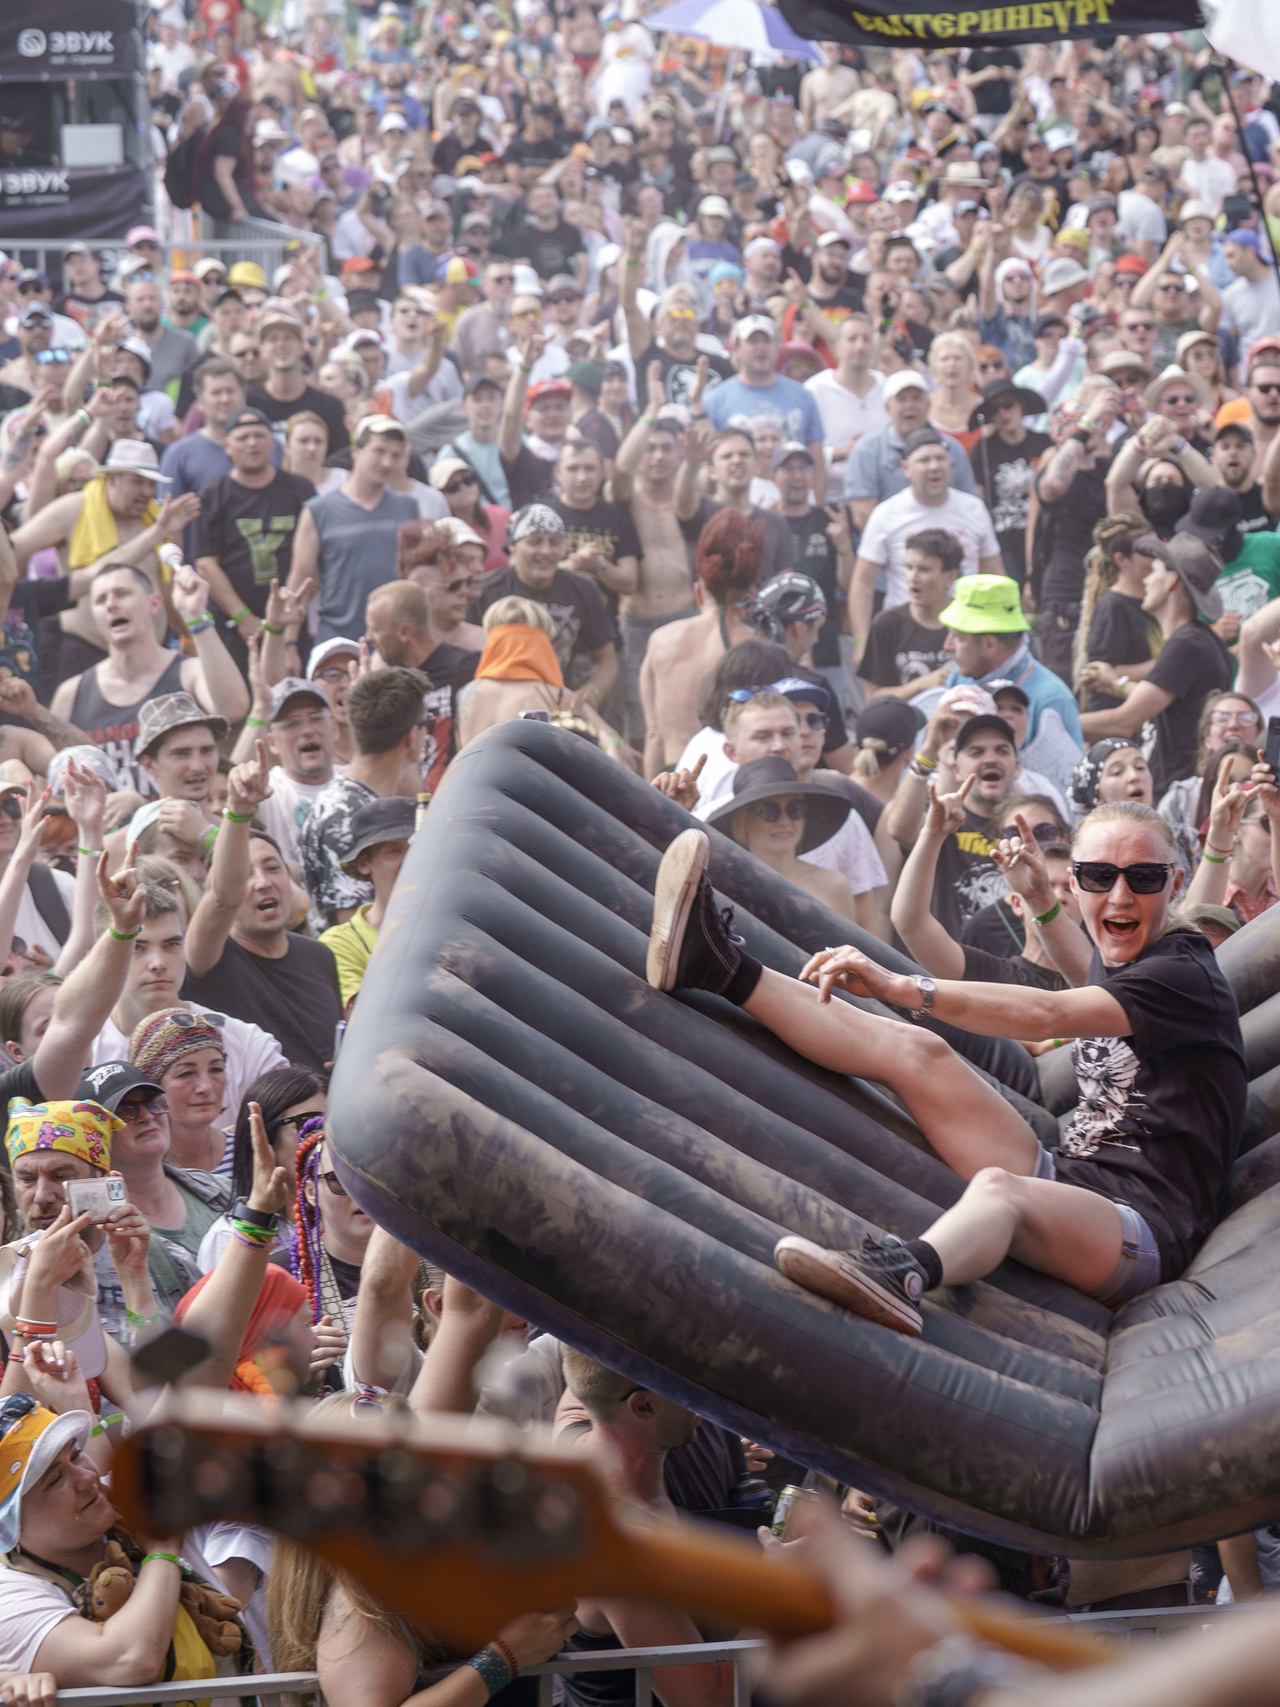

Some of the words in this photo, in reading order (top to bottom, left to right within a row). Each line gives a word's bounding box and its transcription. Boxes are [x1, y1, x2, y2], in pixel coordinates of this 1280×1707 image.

[48, 30, 115, 53] ЗВУК
[4, 168, 71, 194] ЗВУК
[85, 721, 140, 743] ANG
